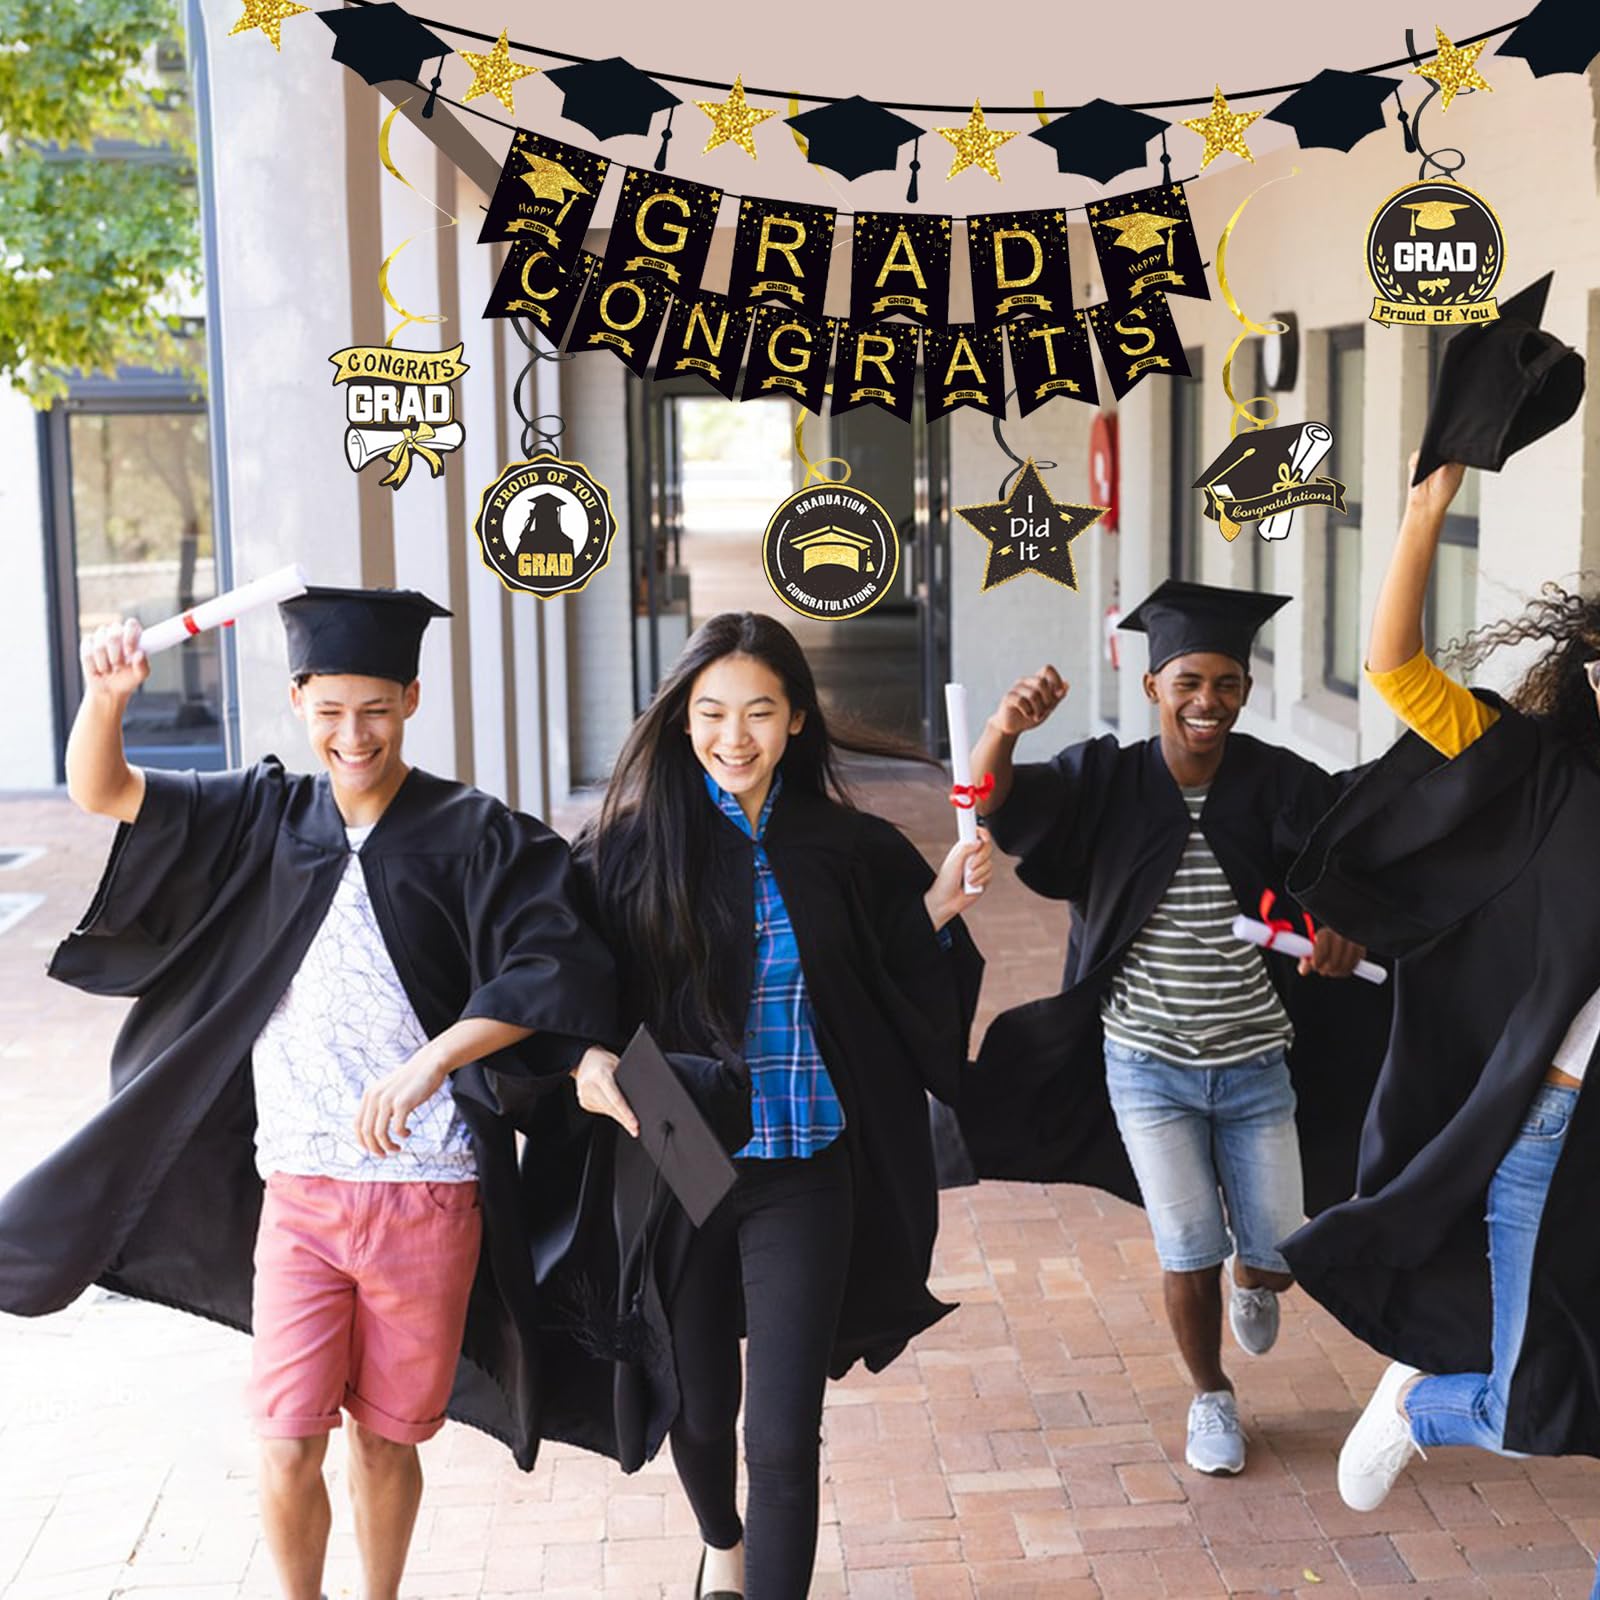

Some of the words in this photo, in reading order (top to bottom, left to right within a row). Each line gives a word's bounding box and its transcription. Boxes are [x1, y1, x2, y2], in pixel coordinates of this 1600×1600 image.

[518, 203, 554, 216] Happy
[523, 220, 551, 235] GRAD!
[642, 258, 669, 270] GRAD!
[1128, 253, 1161, 275] Happy
[1393, 241, 1478, 273] GRAD
[766, 282, 792, 292] GRAD!
[1142, 272, 1169, 284] GRAD!
[887, 296, 914, 305] GRAD!
[1010, 295, 1037, 305] GRAD!
[1379, 306, 1426, 322] Proud
[1433, 309, 1453, 322] Of
[1459, 306, 1490, 321] You
[347, 352, 456, 381] CONGRATS
[347, 384, 453, 424] GRAD
[493, 471, 540, 510] PROUD
[547, 470, 568, 484] OF
[571, 477, 598, 509] YOU
[795, 494, 868, 516] GRADUATION
[1027, 495, 1033, 514] I
[1230, 489, 1332, 521] Congratulations
[1010, 518, 1050, 538] Did
[1019, 541, 1041, 561] It
[517, 552, 574, 577] GRAD
[785, 581, 878, 611] CONGRATULATIONS
